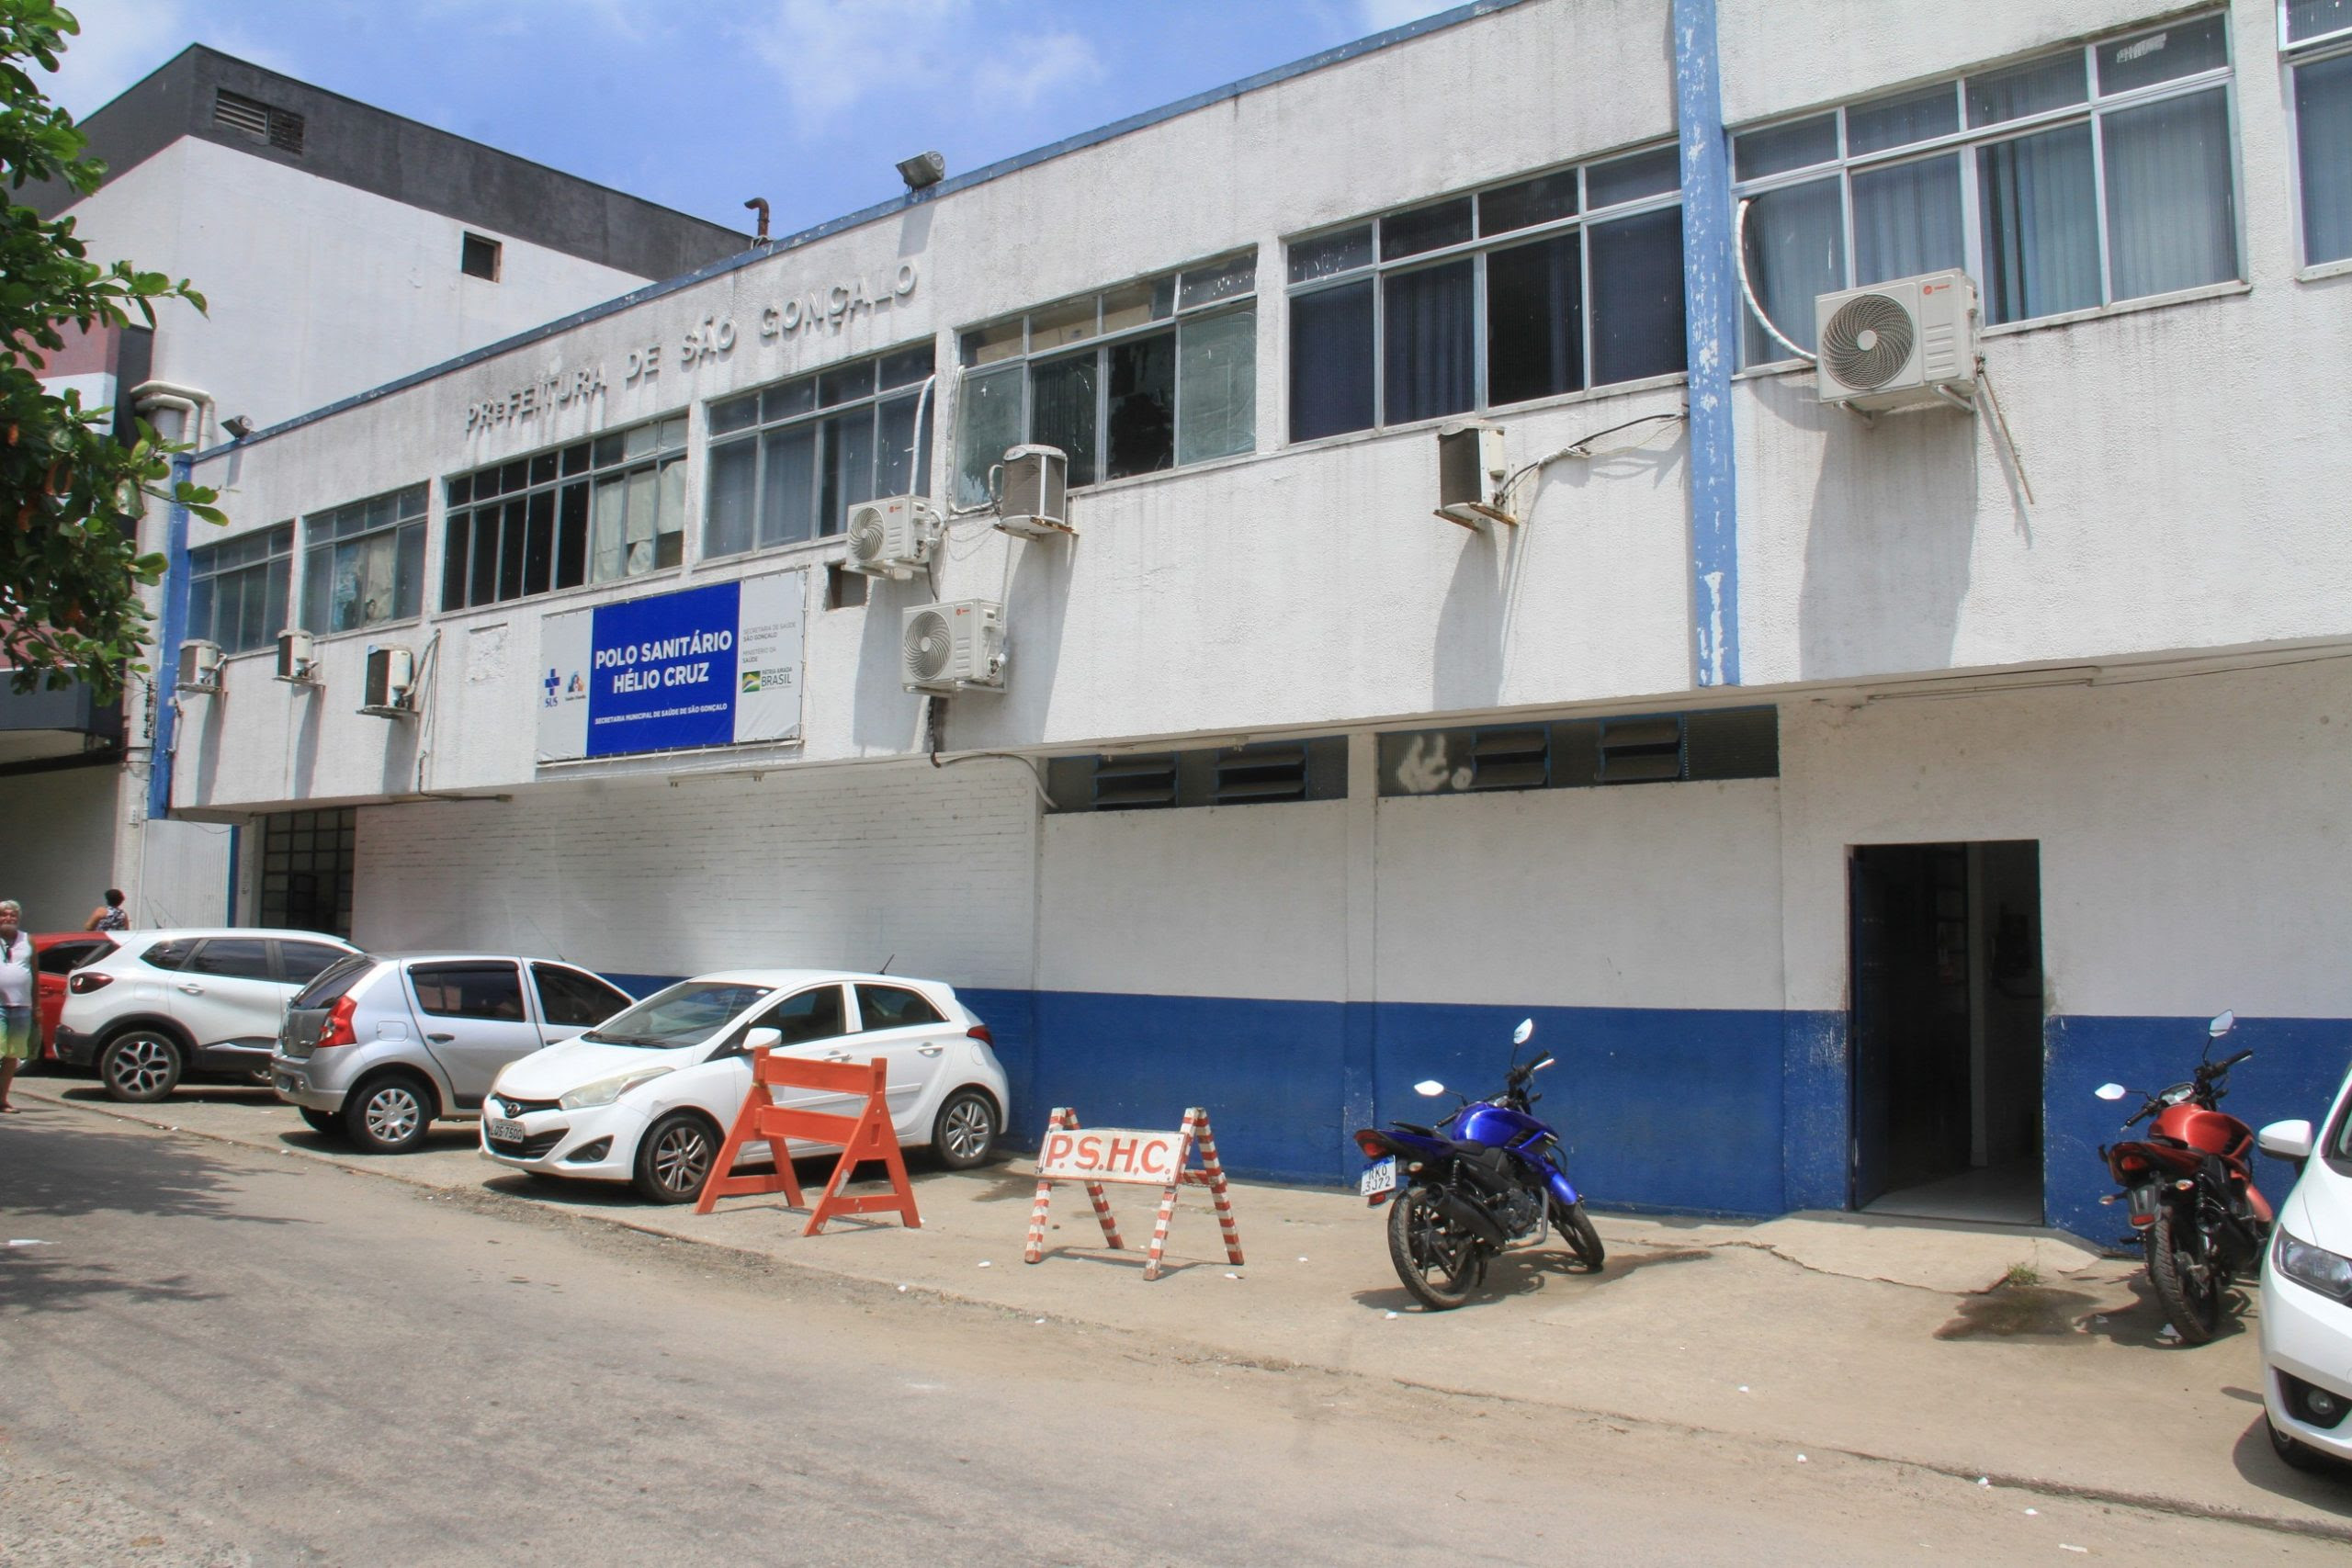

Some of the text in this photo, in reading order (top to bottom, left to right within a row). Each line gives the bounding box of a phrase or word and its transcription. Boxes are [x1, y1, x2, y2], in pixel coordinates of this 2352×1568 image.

[465, 263, 917, 432] PREFEITURA DE SÃO GONÇALO
[595, 629, 732, 670] POLO SANITÁRIO
[613, 662, 709, 694] HÉLIO CRUZ
[761, 673, 792, 687] BRASIL
[545, 697, 558, 707] SUS
[594, 716, 625, 725] SECRETARIA
[626, 712, 652, 721] MUNICIPAL
[662, 707, 679, 717] SAÚDE
[687, 705, 699, 714] SÃO
[700, 702, 728, 713] GONÇALO
